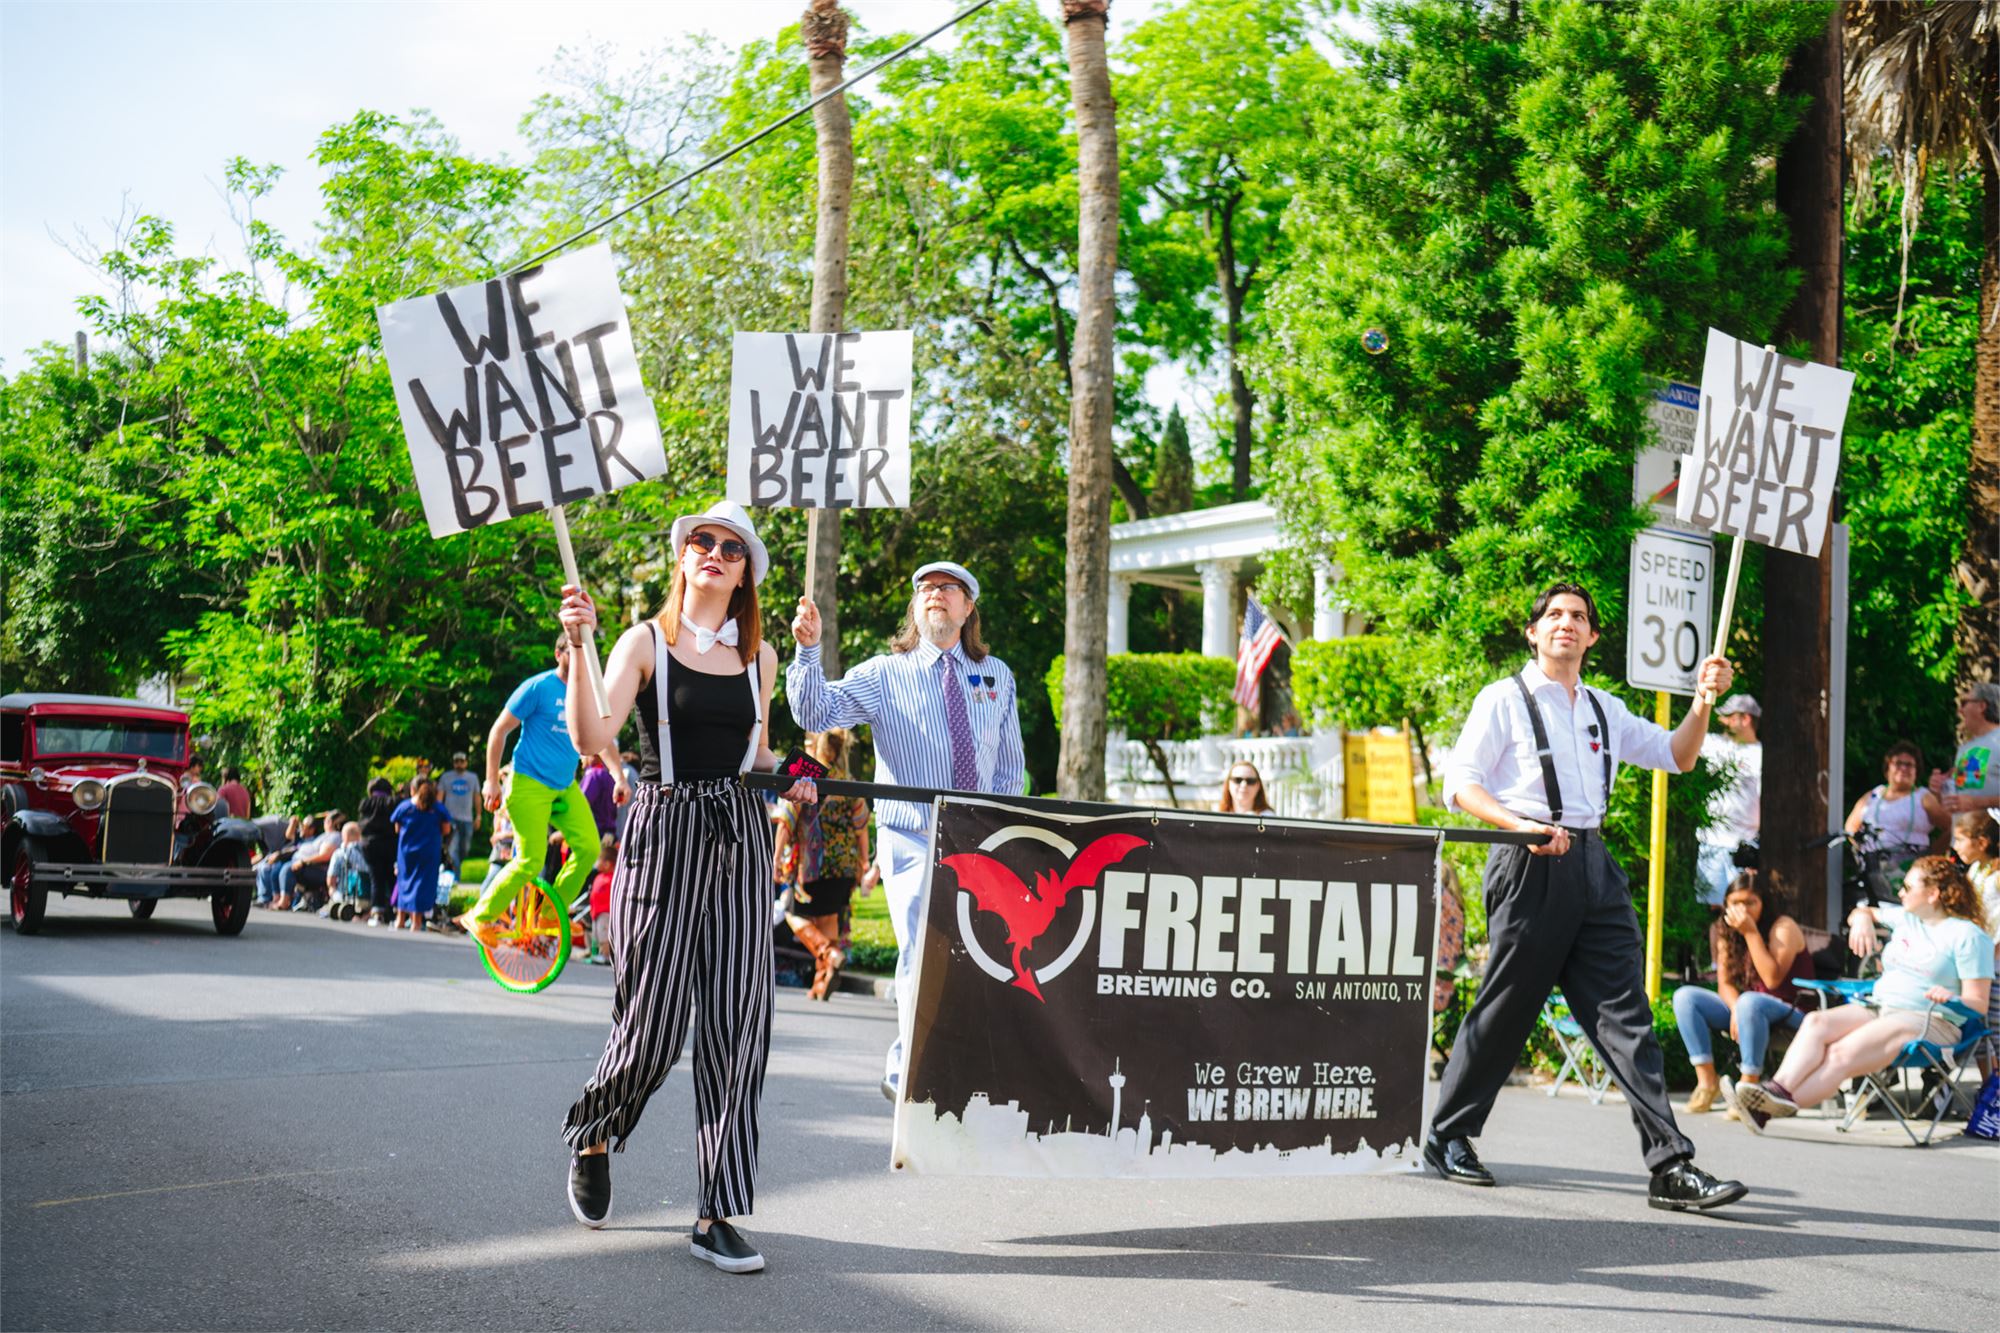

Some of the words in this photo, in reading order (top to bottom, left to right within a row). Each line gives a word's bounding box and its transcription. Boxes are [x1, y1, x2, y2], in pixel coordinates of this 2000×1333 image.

[436, 264, 555, 365] WE
[408, 321, 618, 454] WANT
[785, 332, 861, 392] WE
[1734, 339, 1809, 422] WE
[750, 389, 905, 449] WANT
[1662, 405, 1695, 426] GOOD
[1705, 395, 1836, 491] WANT
[445, 410, 645, 529] BEER
[750, 445, 896, 507] BEER
[1691, 460, 1814, 554] BEER
[1640, 551, 1705, 582] SPEED
[1646, 583, 1696, 612] LIMIT
[1641, 615, 1699, 673] 30
[1098, 871, 1425, 976] FREETAIL
[1097, 973, 1217, 998] BREWING
[1230, 978, 1271, 999] CO.
[1295, 981, 1326, 1000] SAN
[1332, 982, 1402, 1003] ANTONIO,
[1405, 983, 1423, 1001] TX
[1194, 1062, 1226, 1085] We
[1236, 1062, 1301, 1085] Grew
[1312, 1062, 1377, 1085] Here.
[1187, 1088, 1229, 1122] WE
[1233, 1087, 1311, 1121] BREW
[1313, 1086, 1378, 1120] HERE.
